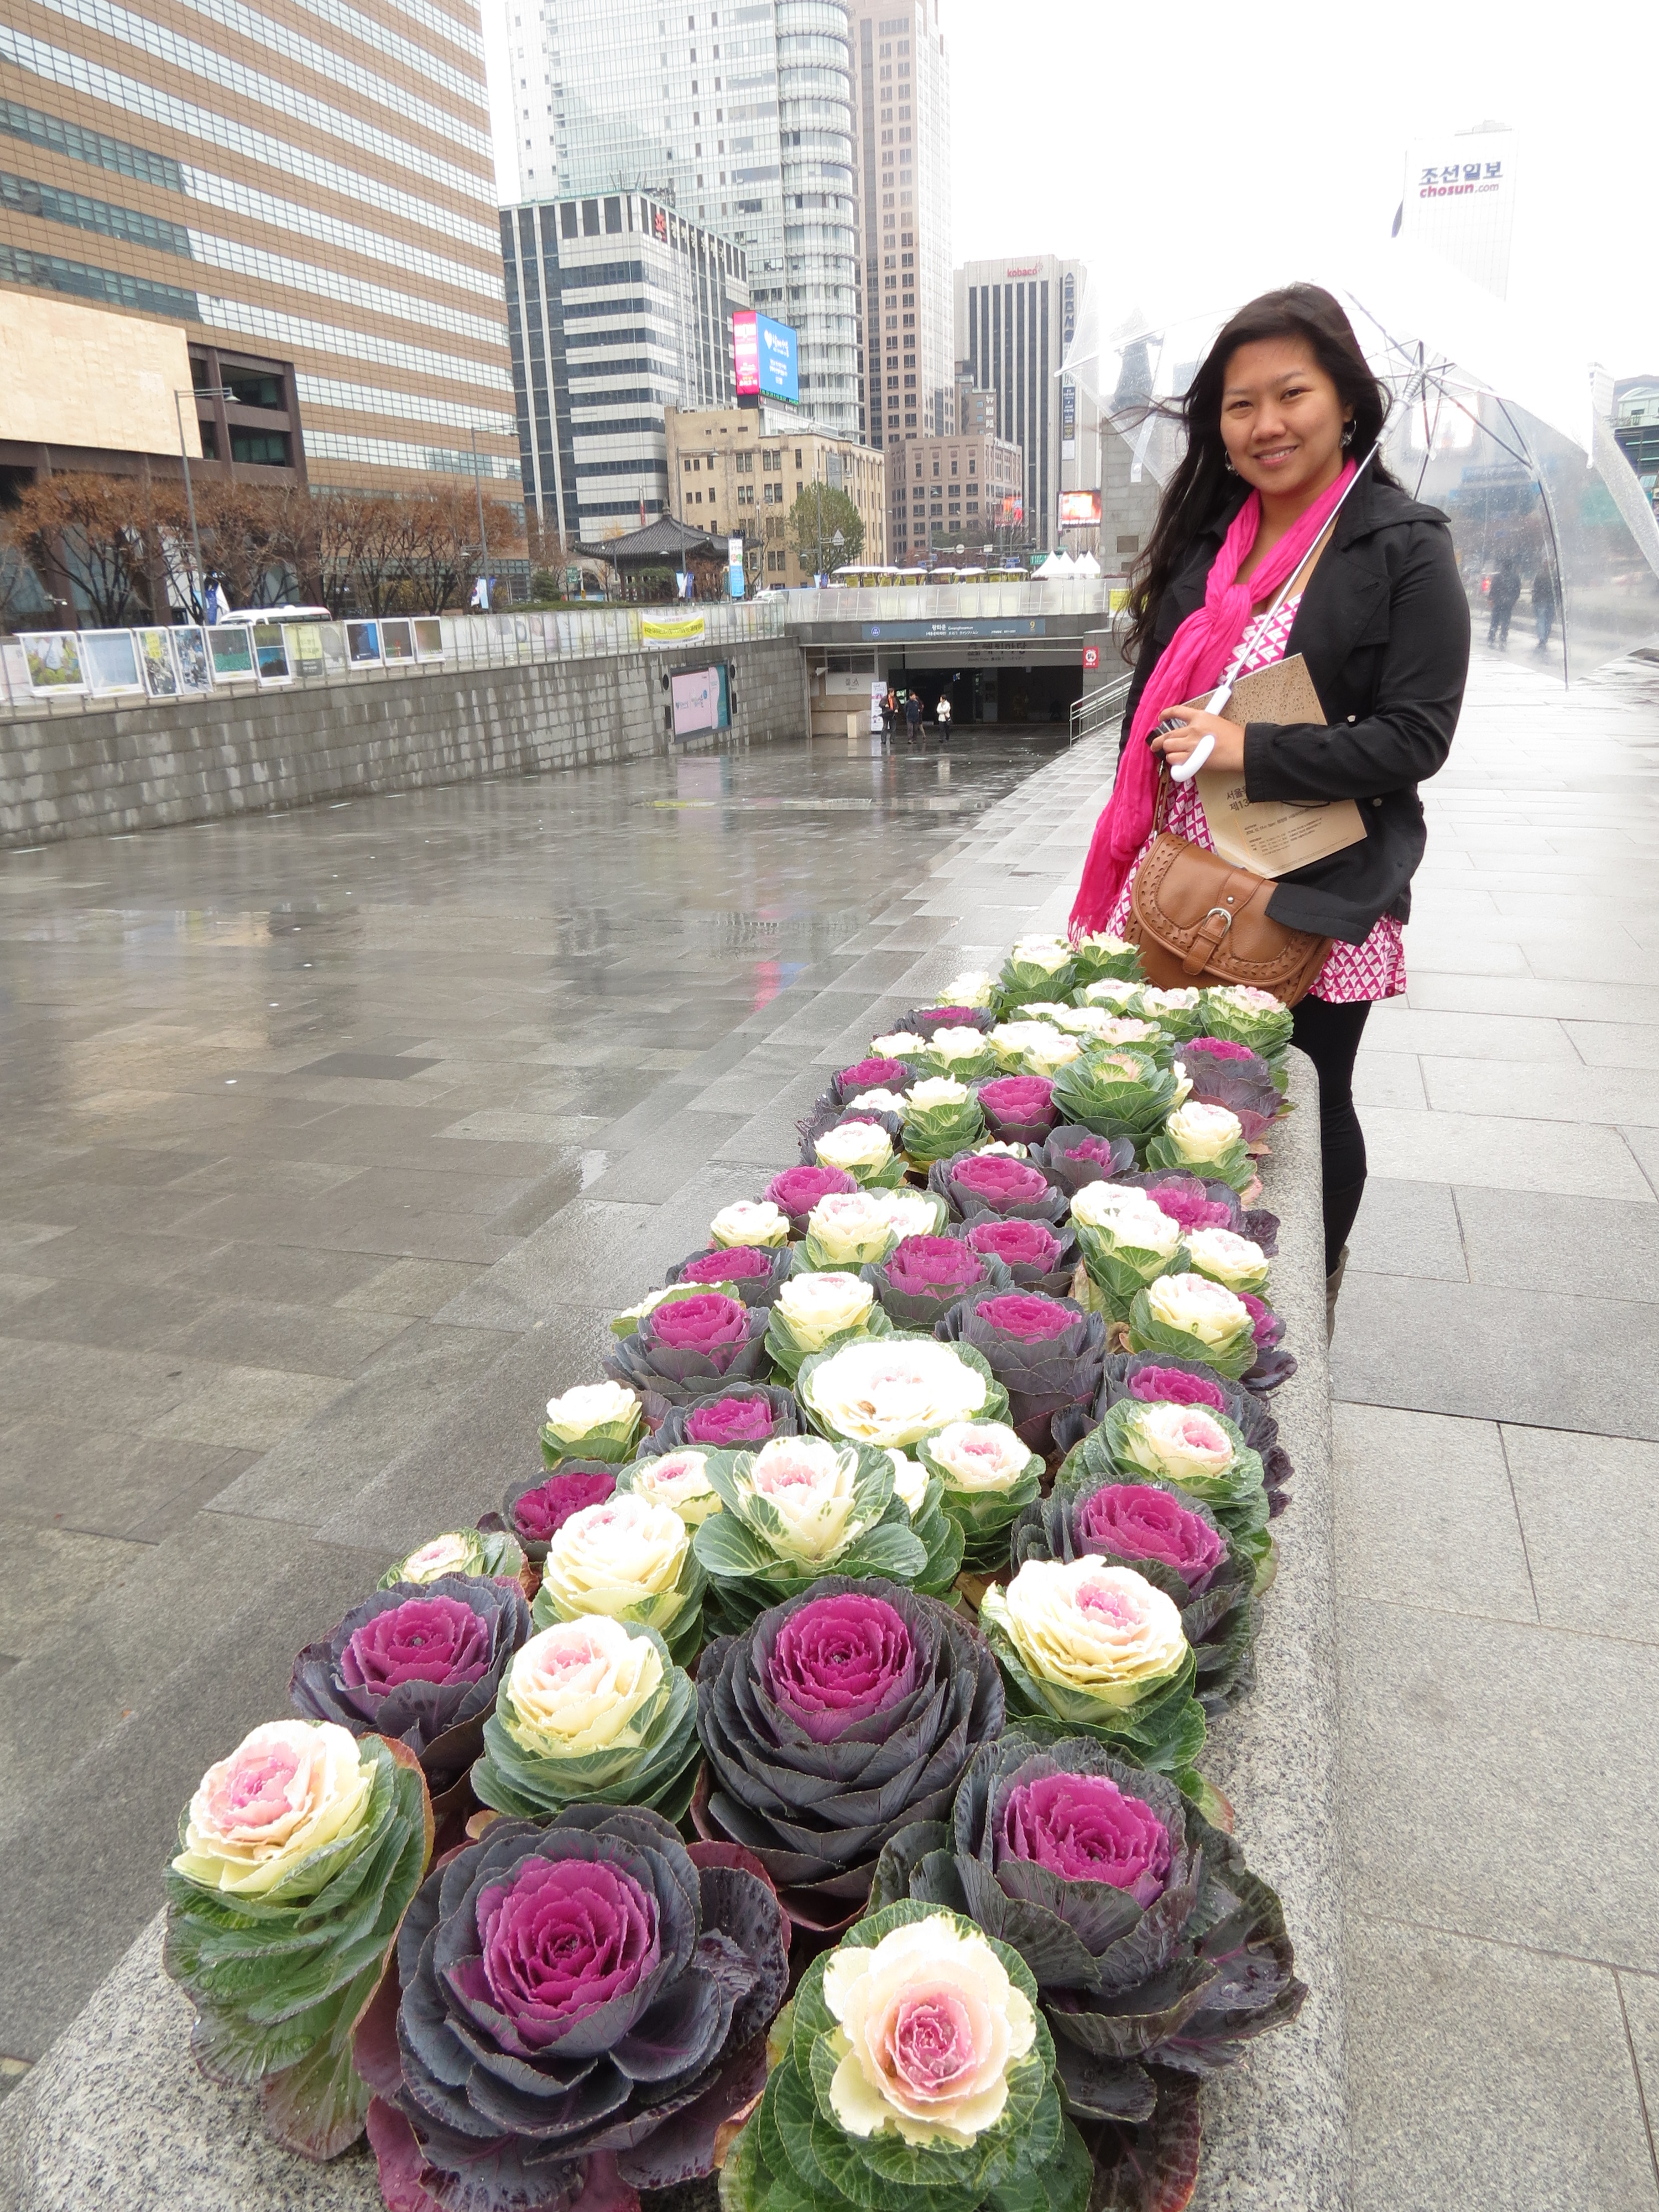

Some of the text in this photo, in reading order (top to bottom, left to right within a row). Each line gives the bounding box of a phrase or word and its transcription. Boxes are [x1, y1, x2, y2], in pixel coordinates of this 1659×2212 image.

[1418, 161, 1503, 186] 조선일보
[1007, 268, 1037, 277] kobaco
[1030, 620, 1036, 629] 9
[1229, 798, 1252, 811] 제13
